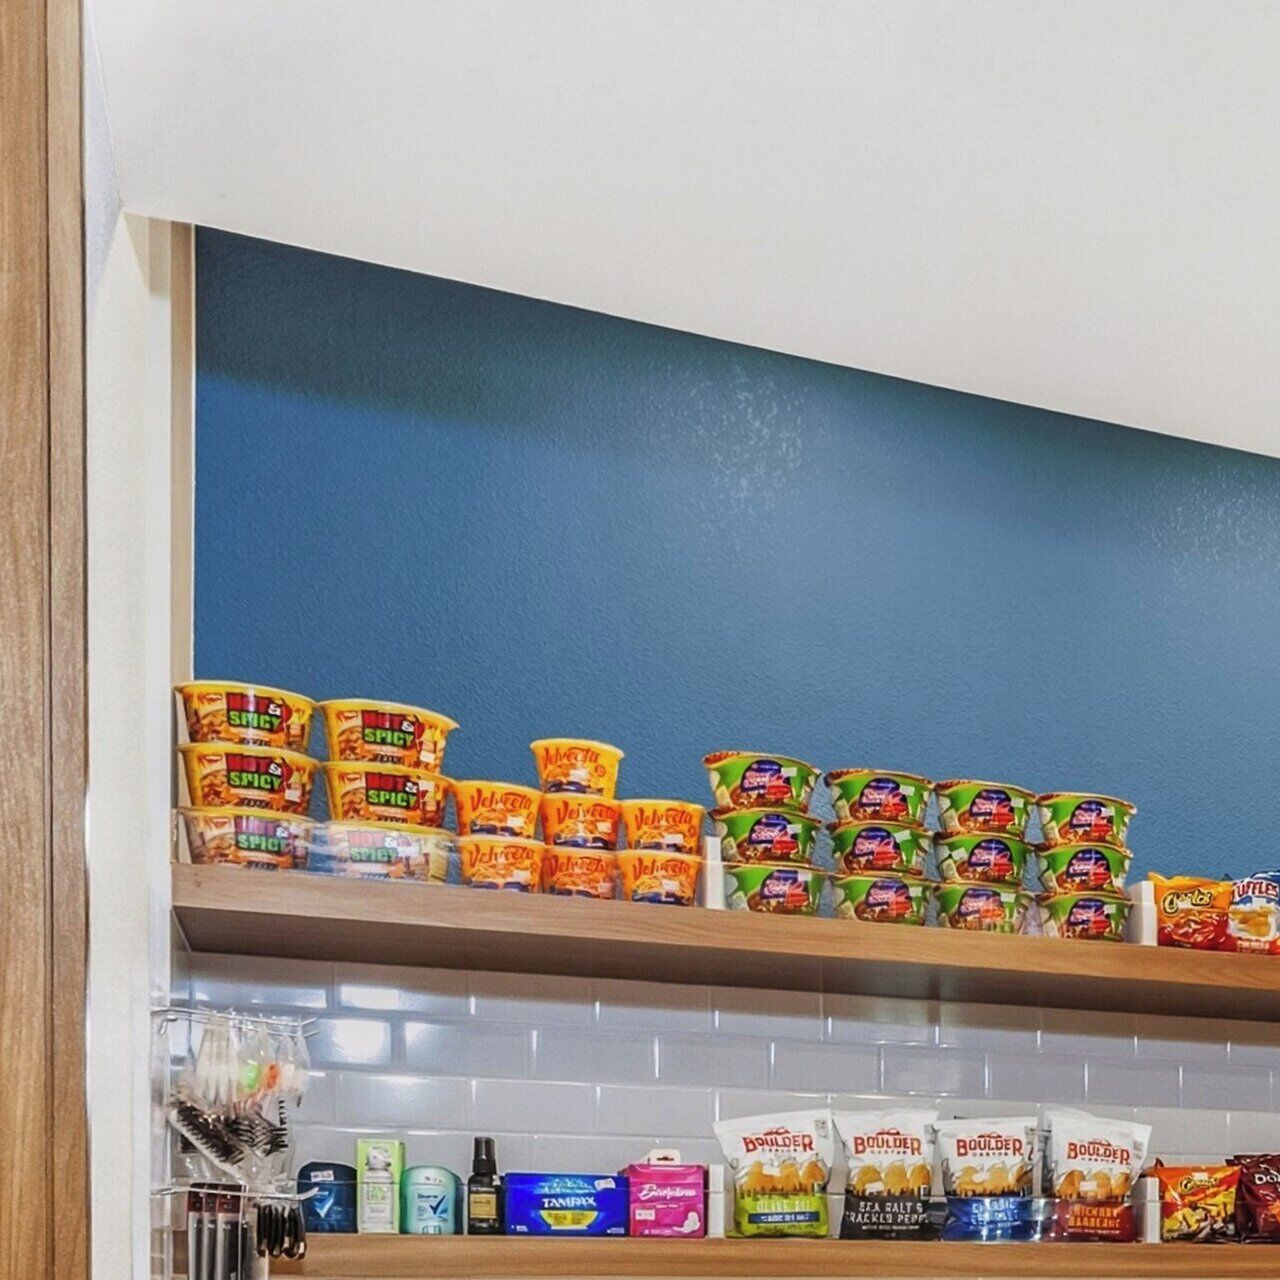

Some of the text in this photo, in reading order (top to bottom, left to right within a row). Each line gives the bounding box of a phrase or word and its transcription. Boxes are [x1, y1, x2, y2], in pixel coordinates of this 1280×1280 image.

[228, 711, 281, 729] SPICY
[364, 728, 414, 746] SPICY
[228, 772, 281, 790] SPICY
[368, 789, 416, 806] SPICY
[237, 833, 285, 851] SPICY
[351, 847, 396, 861] SPICY
[1235, 881, 1279, 900] UFFLES
[742, 1133, 815, 1154] BOULDER
[854, 1136, 922, 1155] BOULDER
[956, 1138, 1024, 1157] BOULDER
[1066, 1142, 1132, 1166] BOULDER
[541, 1196, 597, 1208] TAMPAX
